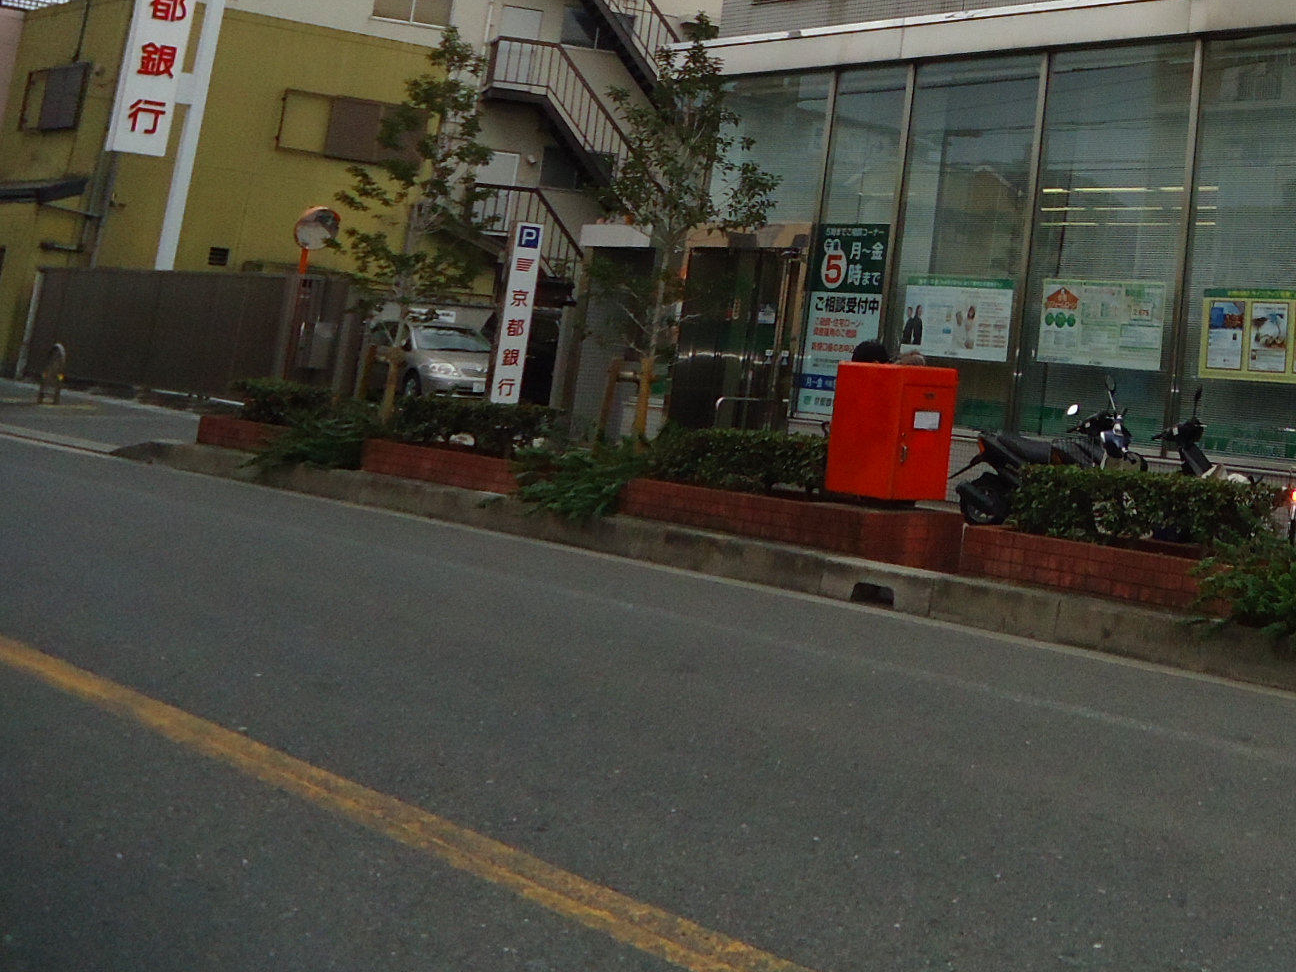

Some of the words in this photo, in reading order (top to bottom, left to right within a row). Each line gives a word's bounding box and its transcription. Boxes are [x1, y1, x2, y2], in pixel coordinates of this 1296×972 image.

[521, 229, 537, 245] P
[815, 296, 880, 315] ご相談受付中
[497, 290, 529, 397] 京都銀行
